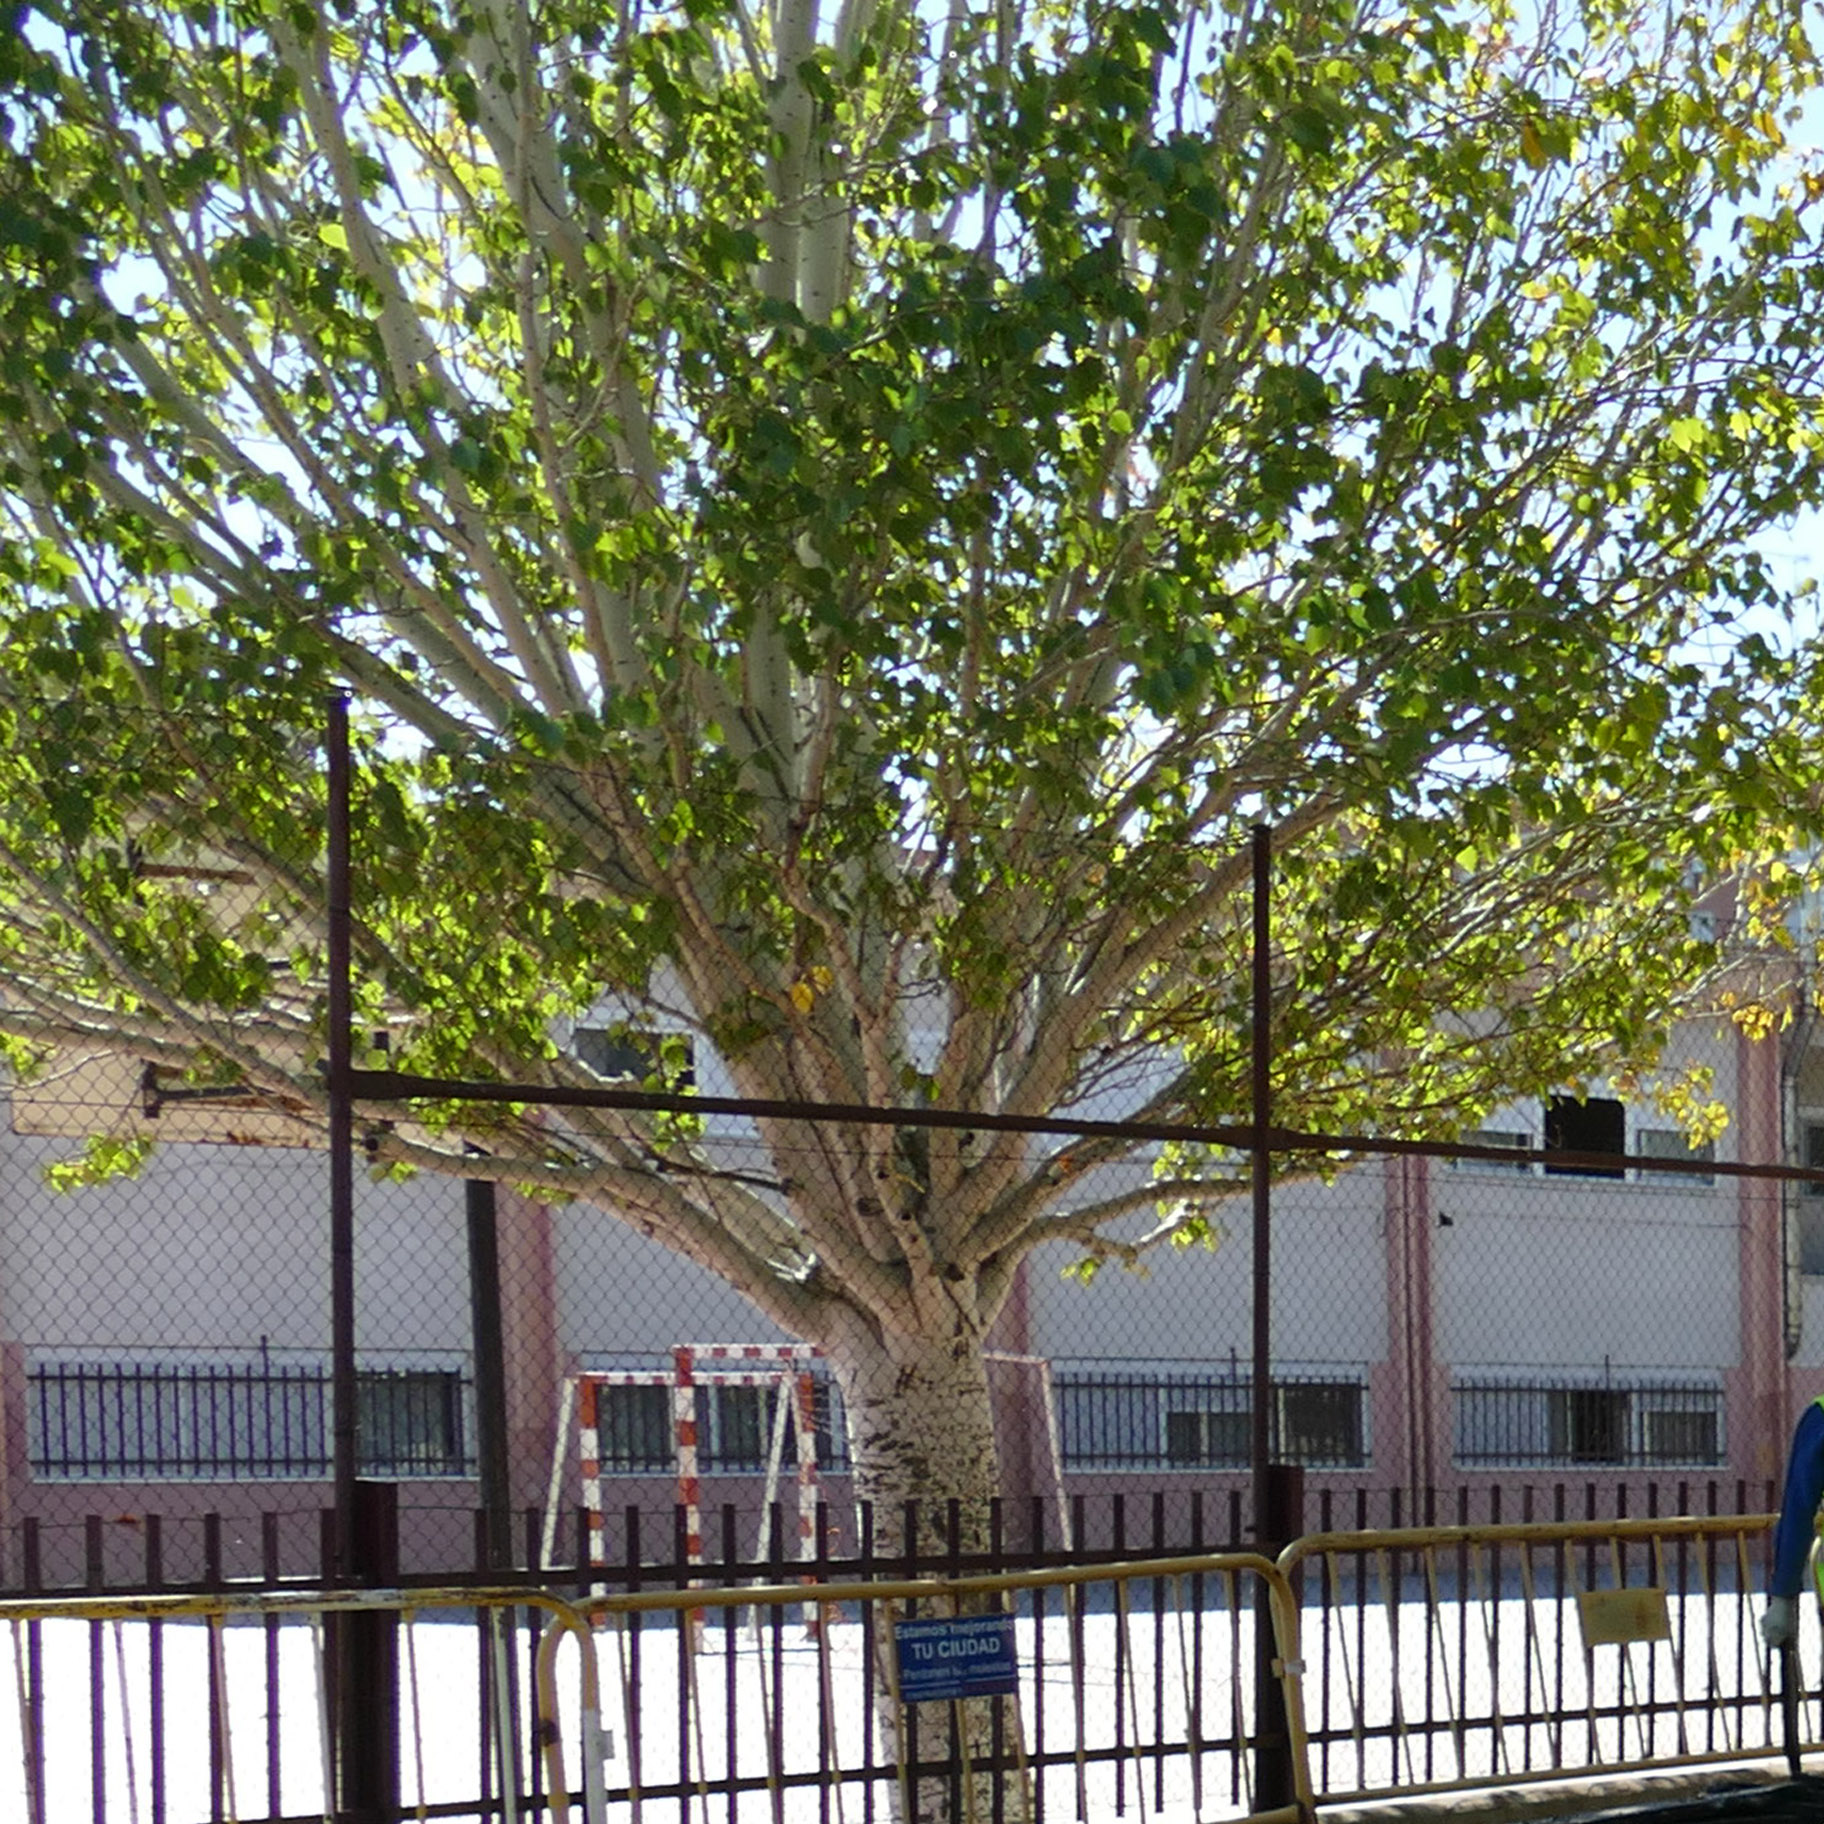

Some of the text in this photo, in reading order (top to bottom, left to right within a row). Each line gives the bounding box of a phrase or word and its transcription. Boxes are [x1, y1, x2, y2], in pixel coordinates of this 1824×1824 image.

[894, 1625, 947, 1641] Estamos
[911, 1637, 1001, 1660] TU CIUDAD
